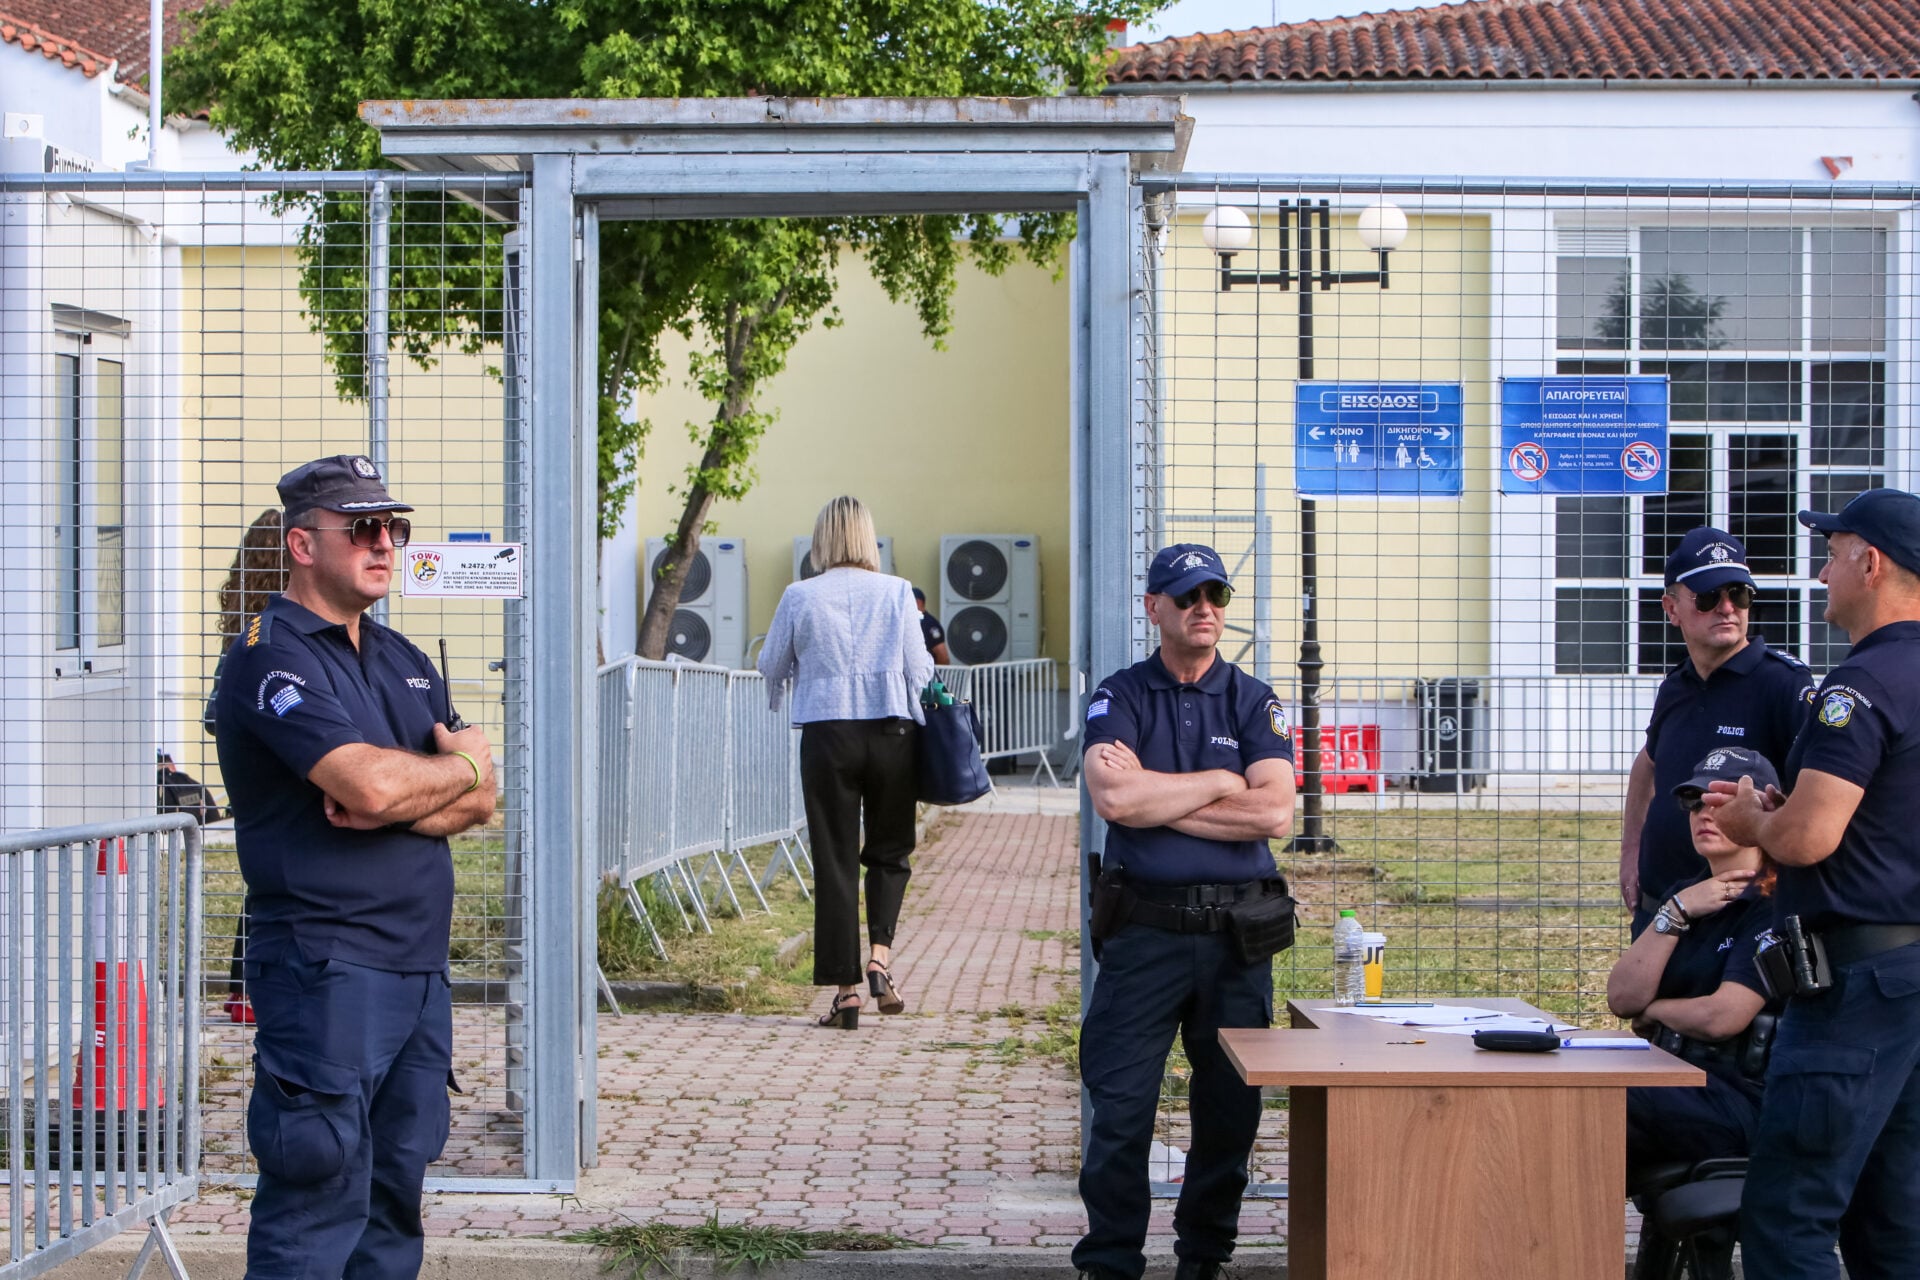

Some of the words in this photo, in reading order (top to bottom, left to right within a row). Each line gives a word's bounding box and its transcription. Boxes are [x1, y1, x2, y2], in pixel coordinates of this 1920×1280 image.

[1546, 392, 1625, 400] ΑΠΑΓΟΡΕΥΕΤΑΙ
[1341, 396, 1418, 408] ΕΙΣΟΔΟΣ
[1330, 427, 1364, 436] ΚΟΙΝΟ
[411, 553, 440, 561] TOWN
[267, 671, 306, 686] ΑΣΤΥΝΟΜΙΑ
[1845, 686, 1872, 709] ΑΣΤΥΝΟΜΙΑ
[1717, 726, 1745, 736] POLICE
[1211, 737, 1239, 749] POLICE
